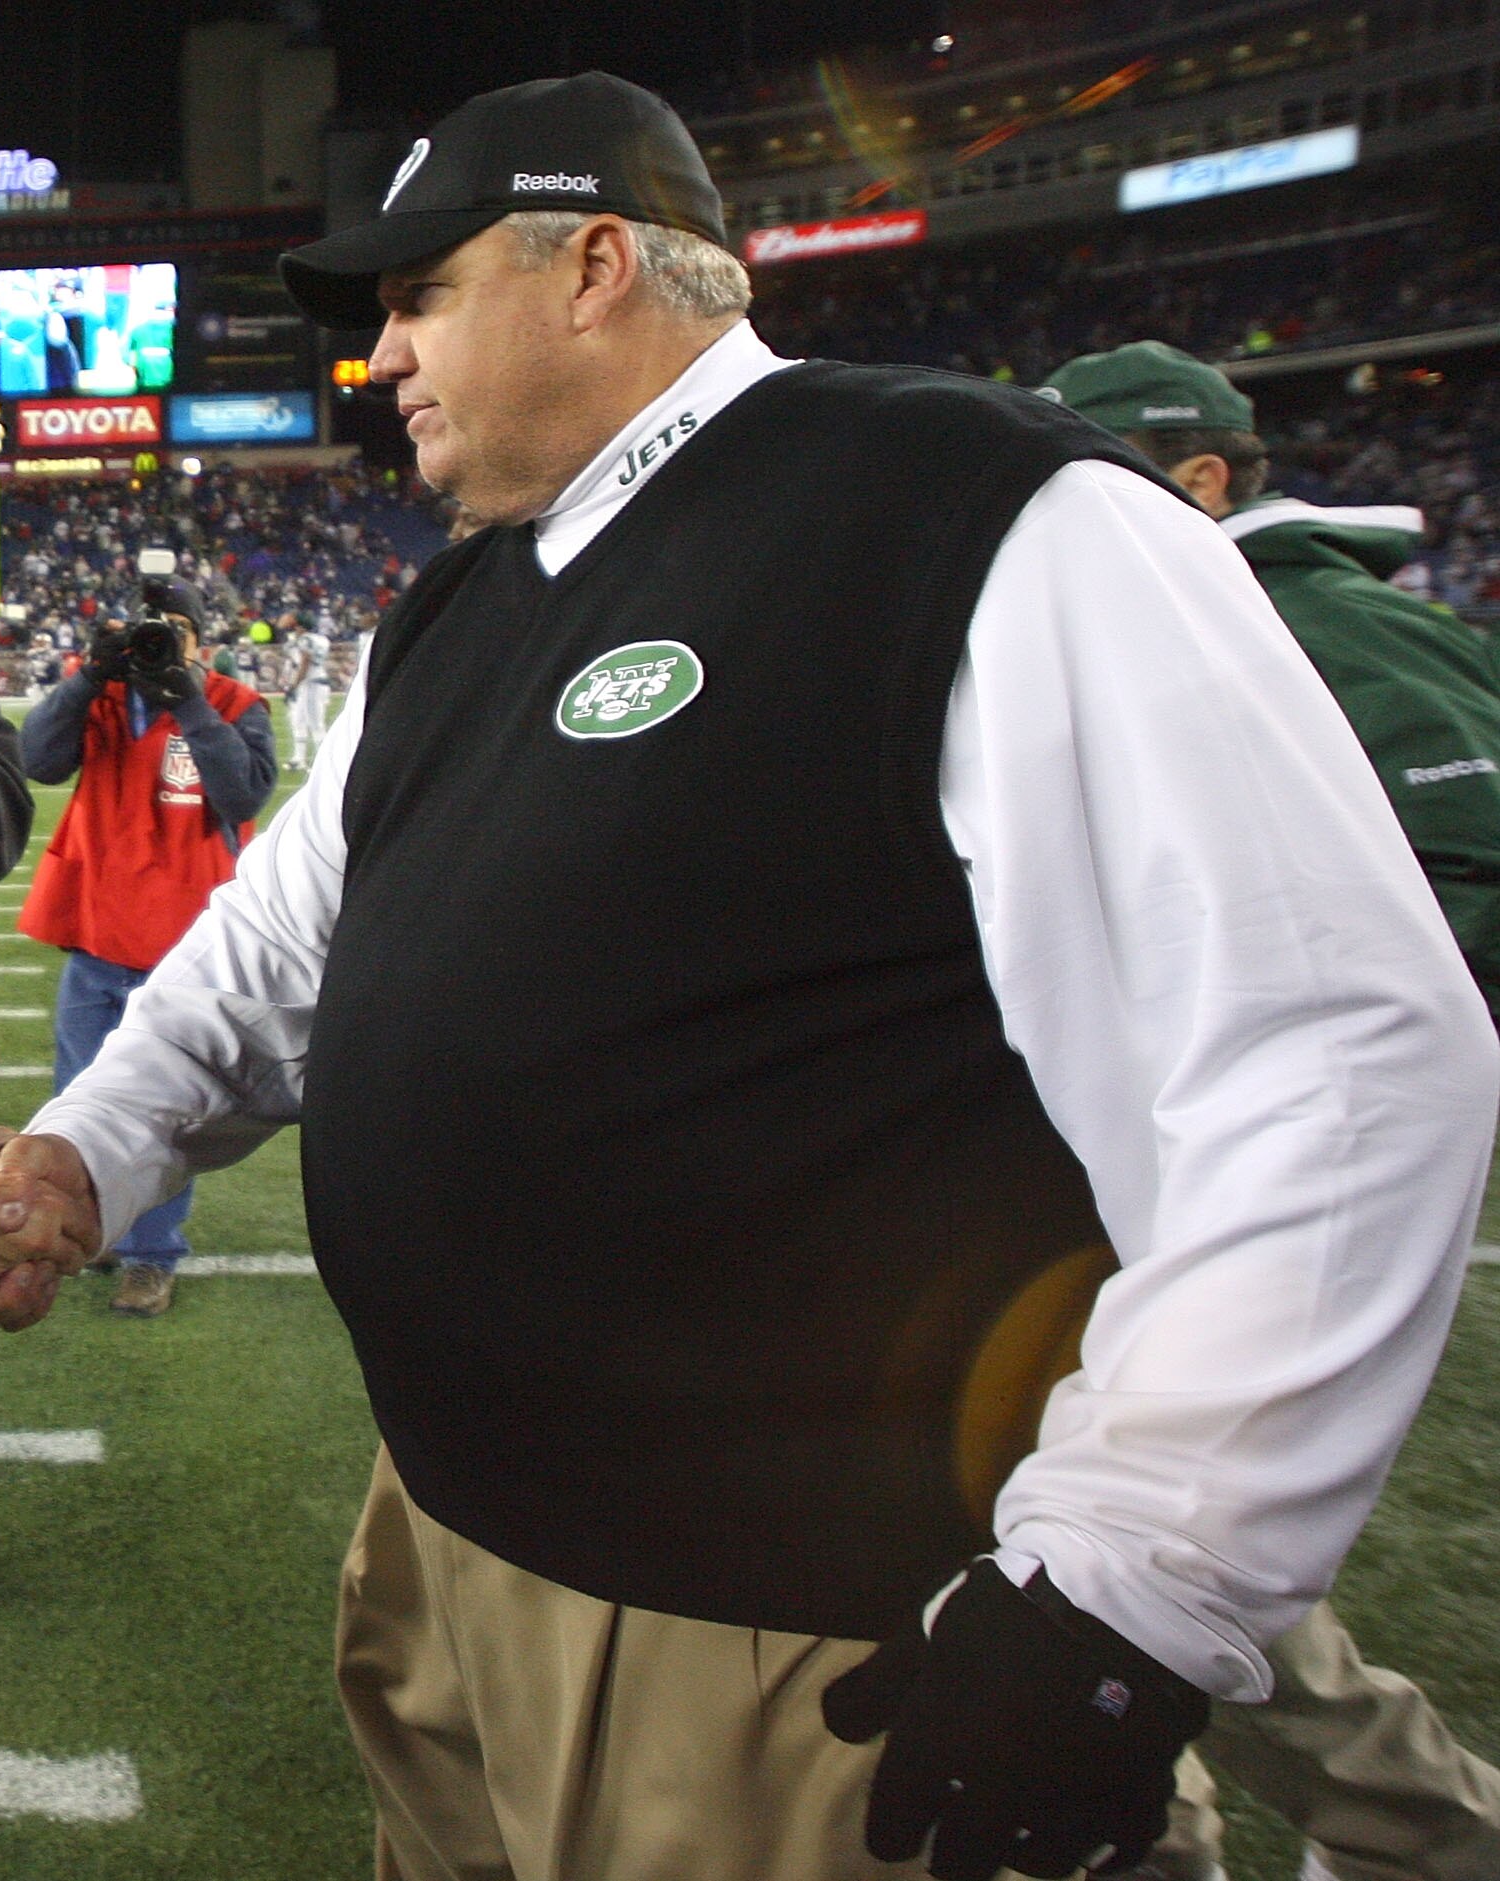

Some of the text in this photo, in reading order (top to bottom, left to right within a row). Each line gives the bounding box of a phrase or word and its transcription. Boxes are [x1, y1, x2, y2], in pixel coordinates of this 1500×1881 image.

[513, 172, 600, 194] Reebok
[21, 405, 157, 436] TOYOTA
[618, 411, 698, 486] JETS
[573, 672, 672, 707] JETS
